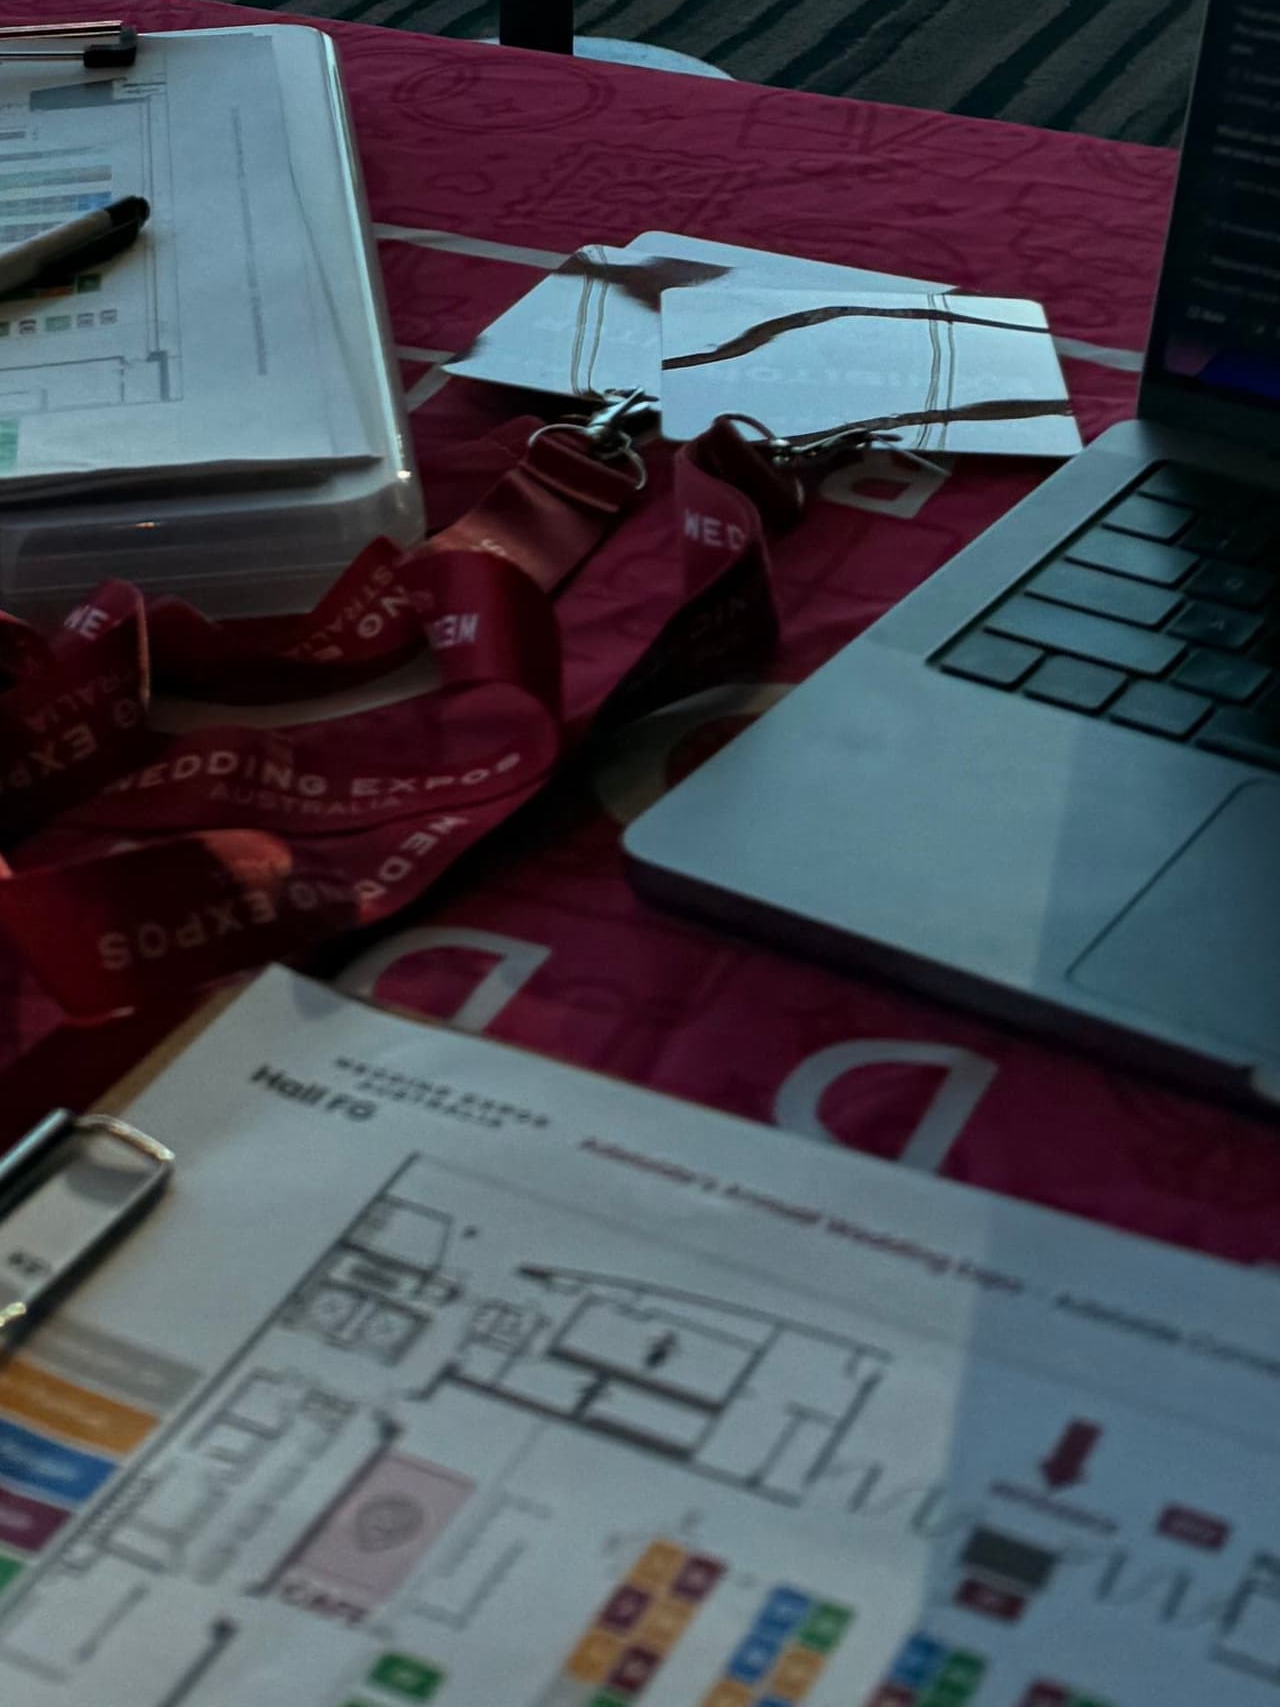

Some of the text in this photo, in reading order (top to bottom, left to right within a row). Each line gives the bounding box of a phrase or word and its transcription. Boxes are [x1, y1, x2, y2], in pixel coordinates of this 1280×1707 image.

[96, 892, 278, 971] EXPOS
[249, 1063, 378, 1123] Hall FG
